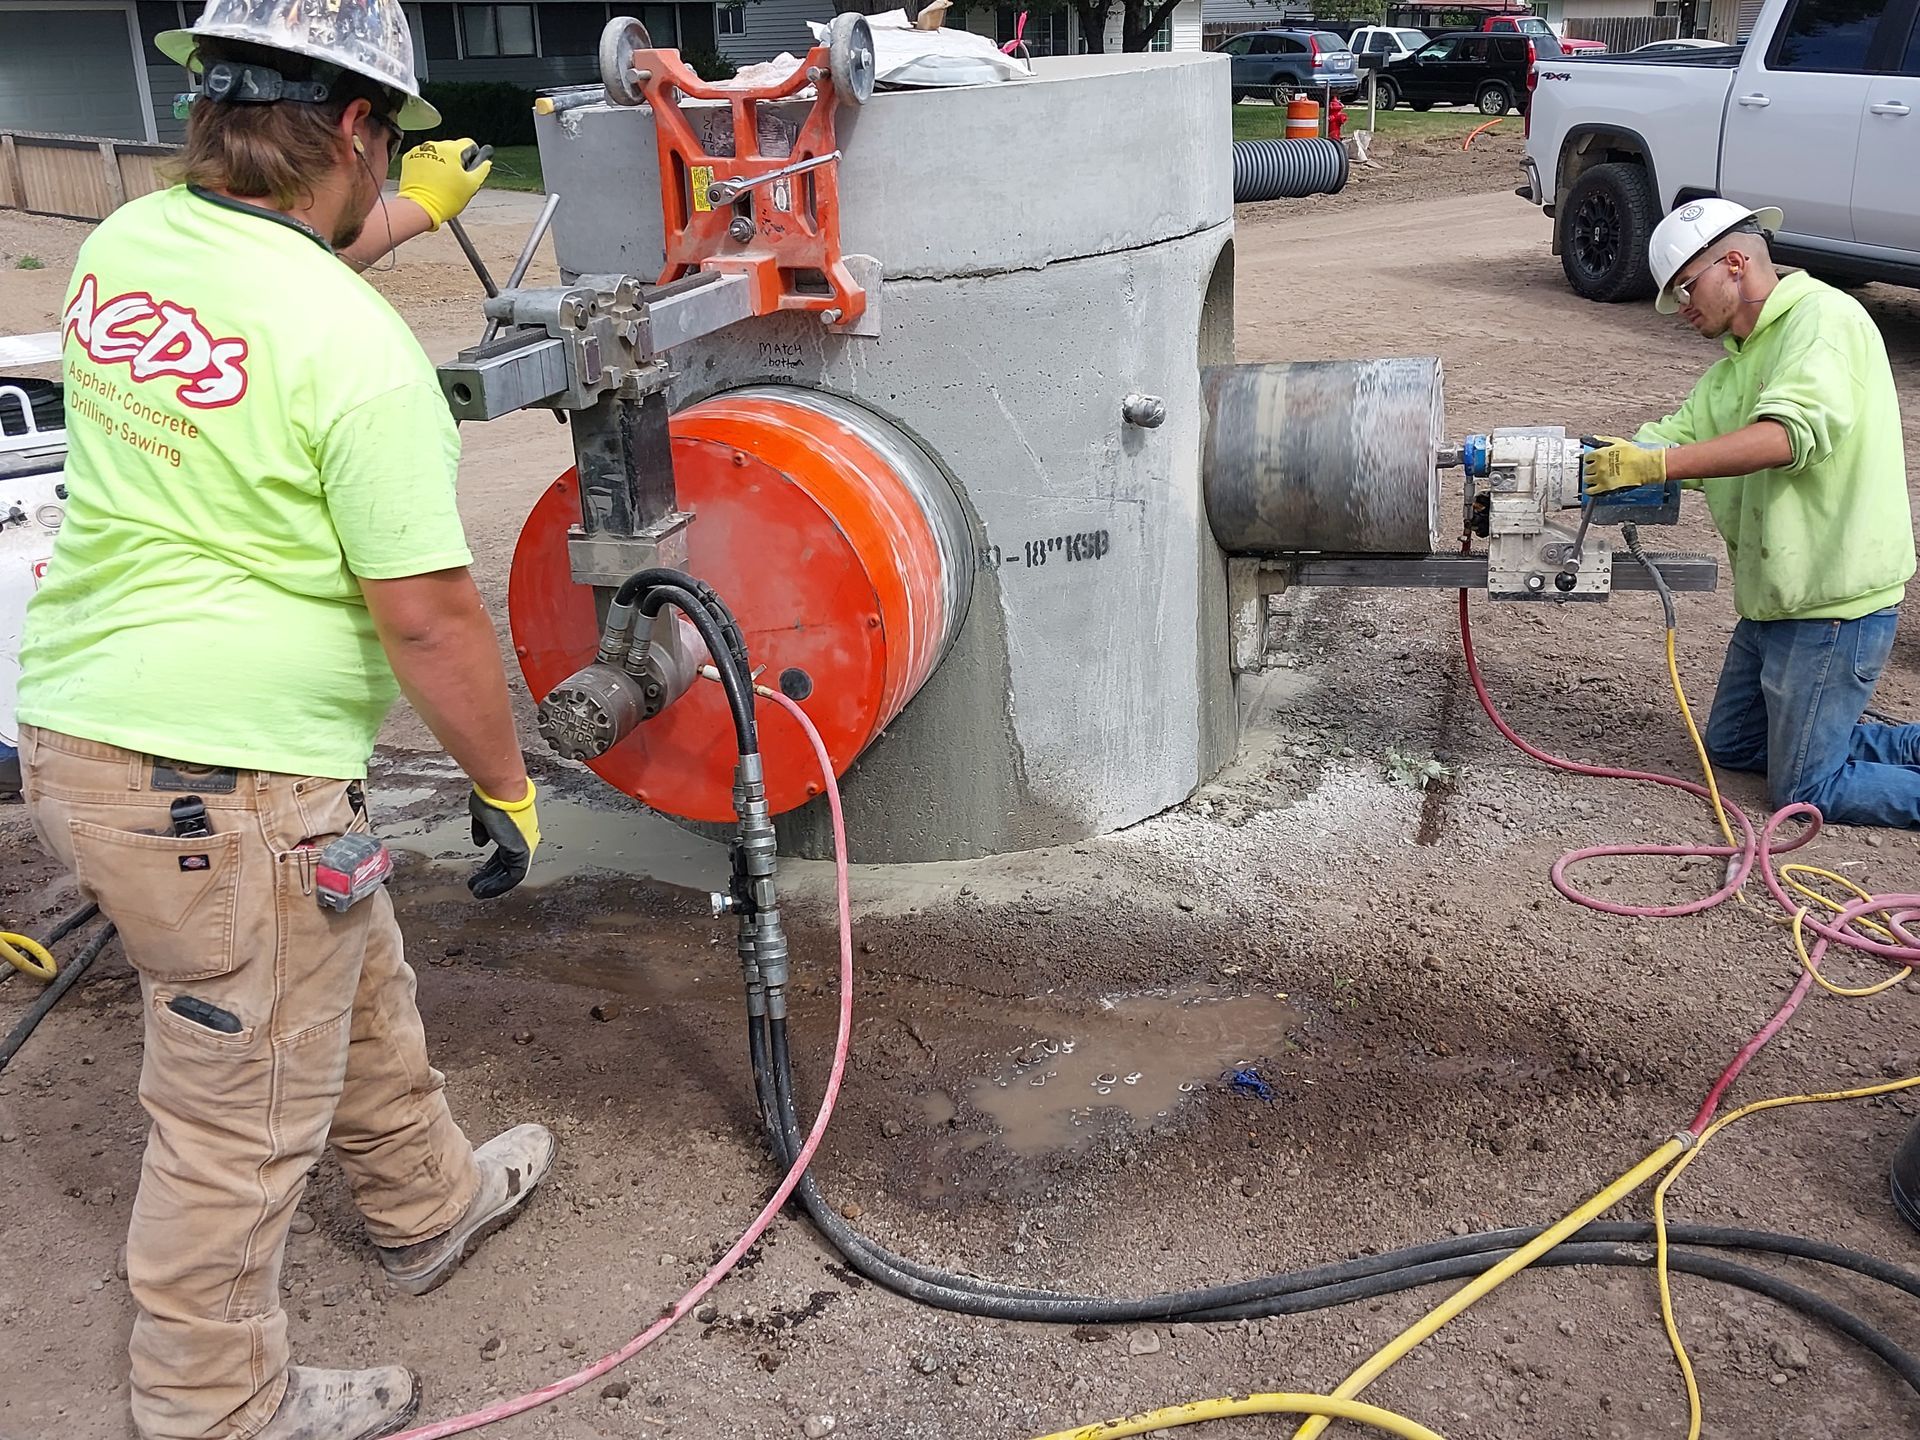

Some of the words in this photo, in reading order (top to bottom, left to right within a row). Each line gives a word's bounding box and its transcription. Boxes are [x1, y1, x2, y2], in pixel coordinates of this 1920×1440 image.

[68, 361, 117, 401] Asphalt
[123, 392, 199, 438] Concrete
[71, 391, 113, 436] Drilling
[120, 423, 181, 467] Sawing
[551, 706, 597, 735] ROLLER
[551, 719, 593, 747] STATOR
